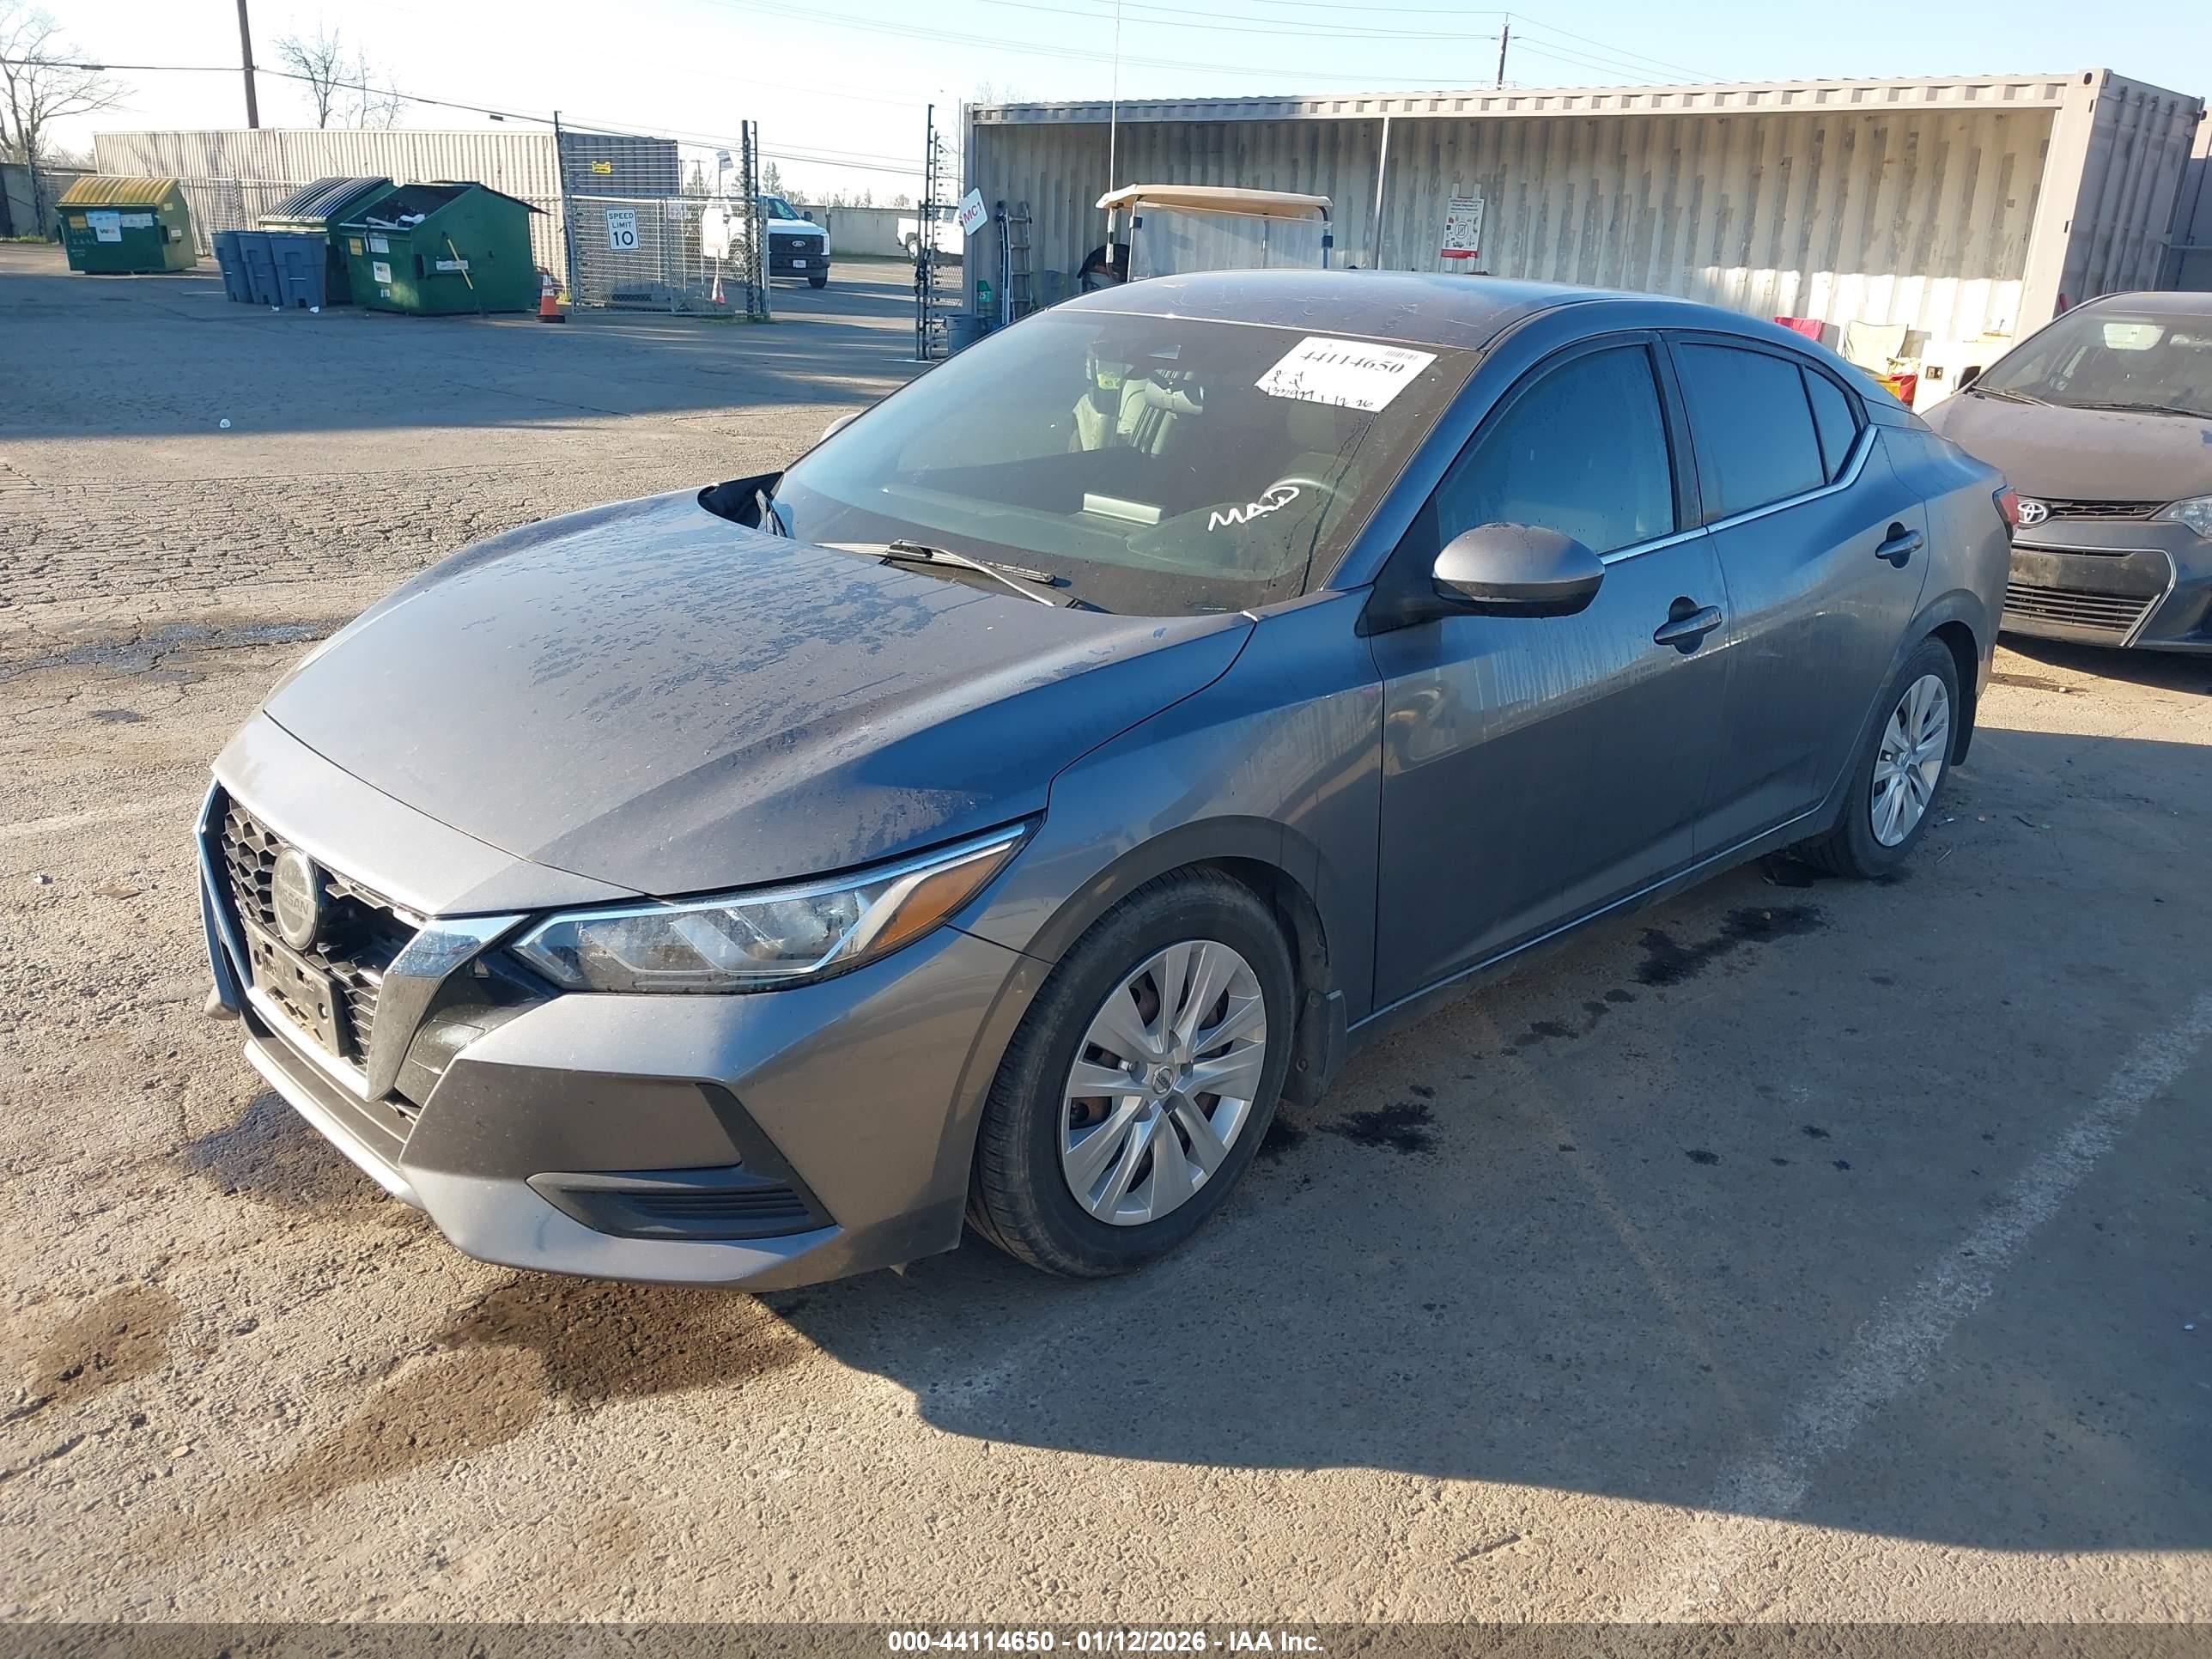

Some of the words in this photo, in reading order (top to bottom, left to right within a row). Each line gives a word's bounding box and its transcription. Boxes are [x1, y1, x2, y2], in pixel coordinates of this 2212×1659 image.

[963, 202, 982, 224] MC1
[613, 230, 634, 246] 10
[1300, 351, 1405, 374] 44114650
